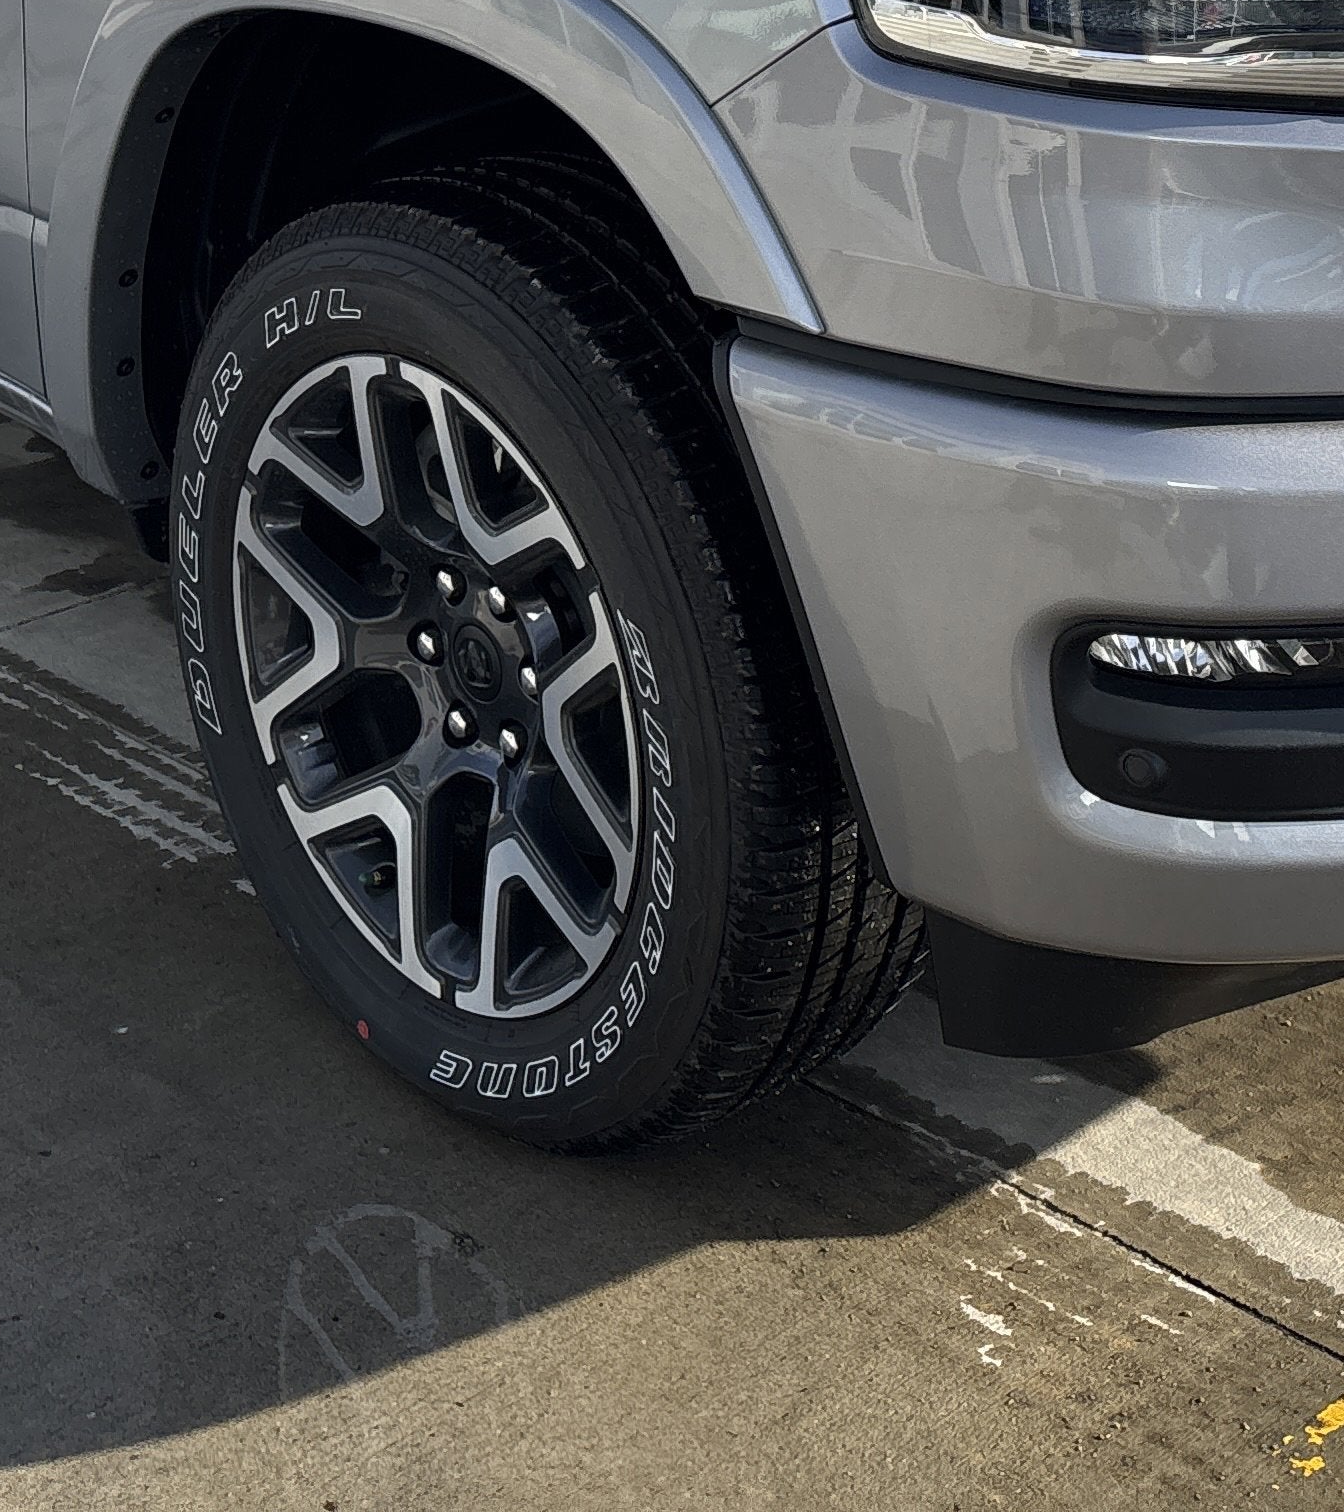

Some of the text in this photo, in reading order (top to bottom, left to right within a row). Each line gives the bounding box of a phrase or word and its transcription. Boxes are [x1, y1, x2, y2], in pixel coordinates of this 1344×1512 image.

[173, 288, 363, 735] DUELER H/L
[430, 608, 676, 1099] BRIDGESTONE
